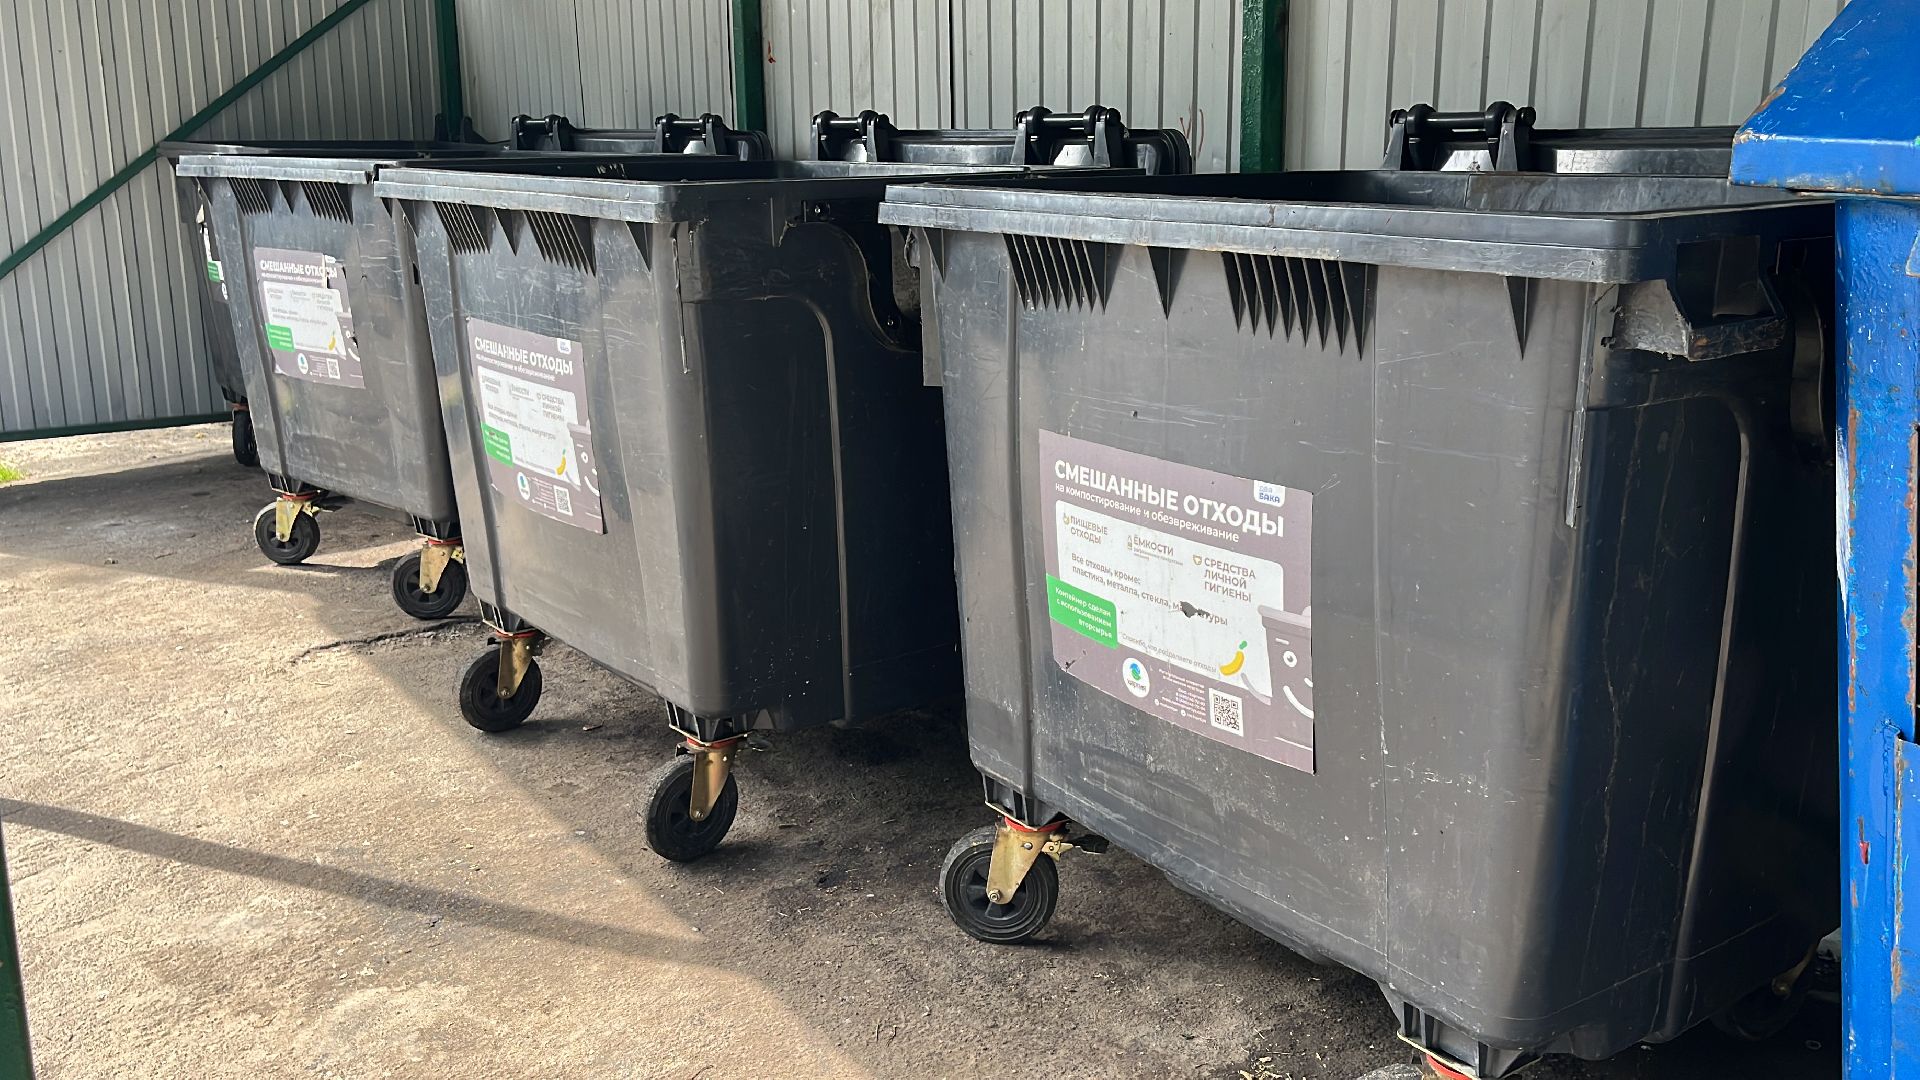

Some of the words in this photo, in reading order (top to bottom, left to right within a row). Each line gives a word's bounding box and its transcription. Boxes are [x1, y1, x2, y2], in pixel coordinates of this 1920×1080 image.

[305, 264, 338, 279] ОТХЫ
[474, 336, 529, 365] СМЕШАННЫЕ
[529, 351, 573, 376] ОТХОДЫ
[1054, 459, 1179, 512] СМЕШАННЫЕ
[1183, 494, 1284, 538] ОТХОДЫ
[1258, 492, 1281, 504] БАКА
[1055, 482, 1065, 493] на
[1065, 486, 1141, 516] компостирование
[1143, 510, 1150, 519] и
[1151, 511, 1240, 543] обезвреживание
[1070, 515, 1109, 535] ПИЩЕВЫЕ
[1070, 527, 1102, 545] ОТХОДЫ
[1133, 534, 1174, 557] ЁМКОСТИ
[1071, 552, 1084, 565] Все
[1204, 557, 1257, 580] СРЕДСТВА
[1204, 569, 1247, 590] ЛИЧНОЙ
[1072, 566, 1106, 586] пластика,
[1106, 579, 1140, 598] металла,
[1141, 591, 1172, 610] стекла,
[1172, 600, 1228, 627] матуры
[1204, 581, 1252, 603] ГИГИЕНЫ
